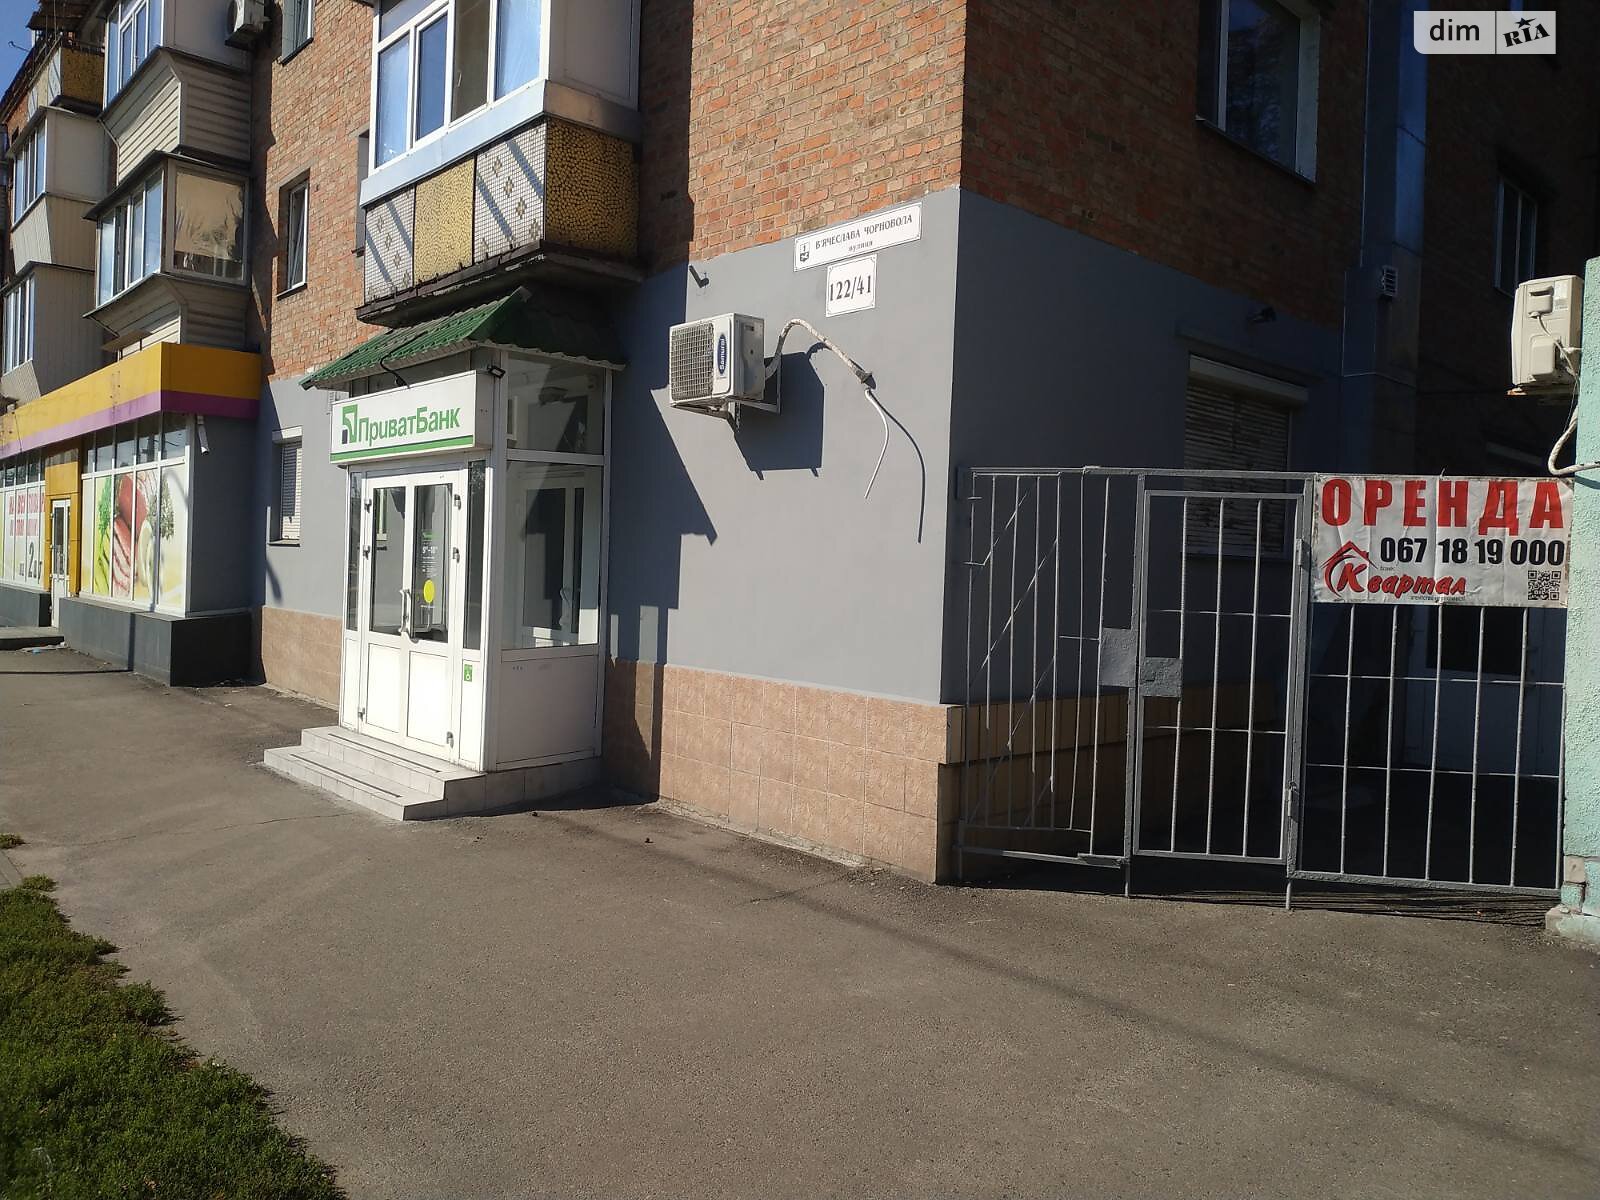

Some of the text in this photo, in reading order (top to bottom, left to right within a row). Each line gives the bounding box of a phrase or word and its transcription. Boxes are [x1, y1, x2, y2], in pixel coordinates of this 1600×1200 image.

[815, 214, 912, 250] В'ЯЧЕСЛАВА ЧОРНОВОЛА
[829, 275, 871, 301] 122/41
[359, 406, 460, 447] ПриватБанк
[1322, 479, 1564, 536] ОРЕНДА
[1380, 537, 1565, 566] 067 18 19 000
[1336, 562, 1467, 599] Квартал
